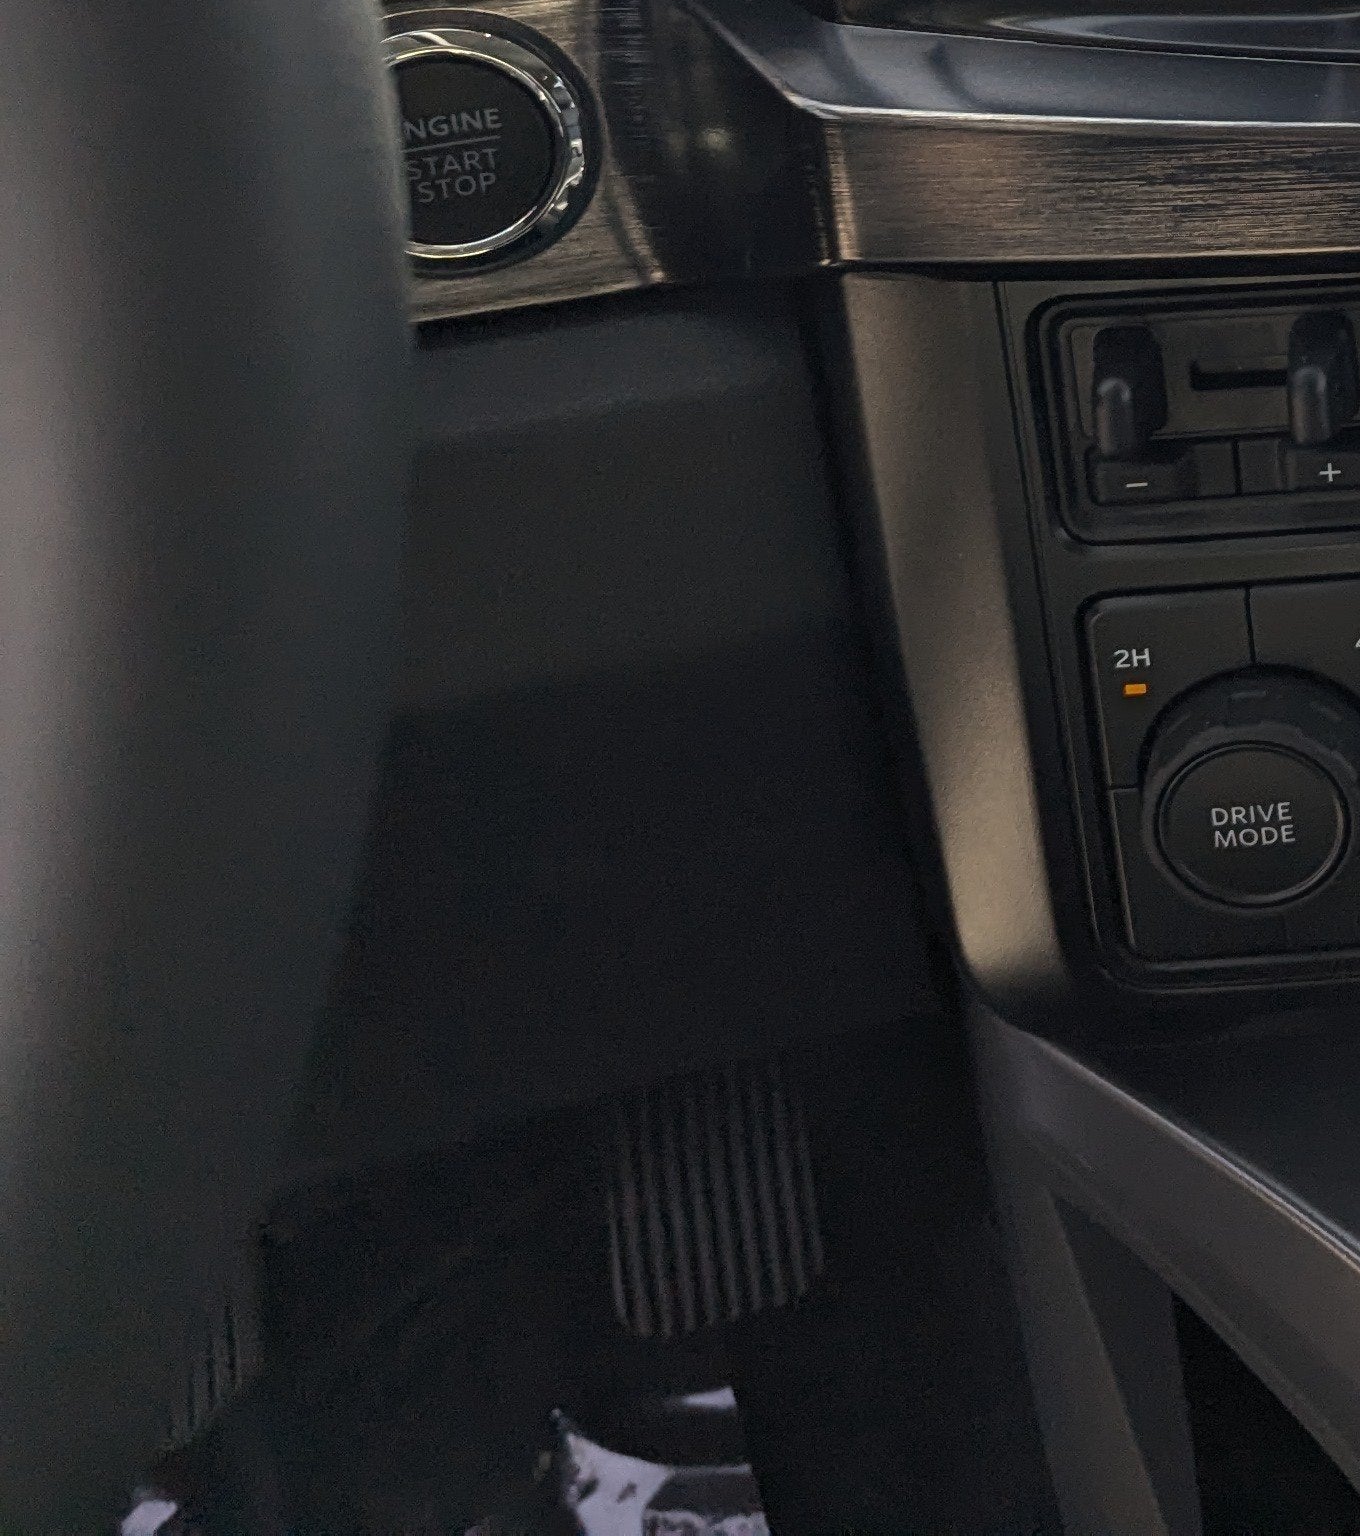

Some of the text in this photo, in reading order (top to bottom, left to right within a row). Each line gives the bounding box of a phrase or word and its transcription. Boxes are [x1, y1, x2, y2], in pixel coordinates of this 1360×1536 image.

[402, 107, 503, 141] NGINE
[417, 171, 497, 204] STOP
[1113, 647, 1152, 669] 2H
[1210, 801, 1294, 827] DRIVE
[1213, 823, 1297, 849] MODE
